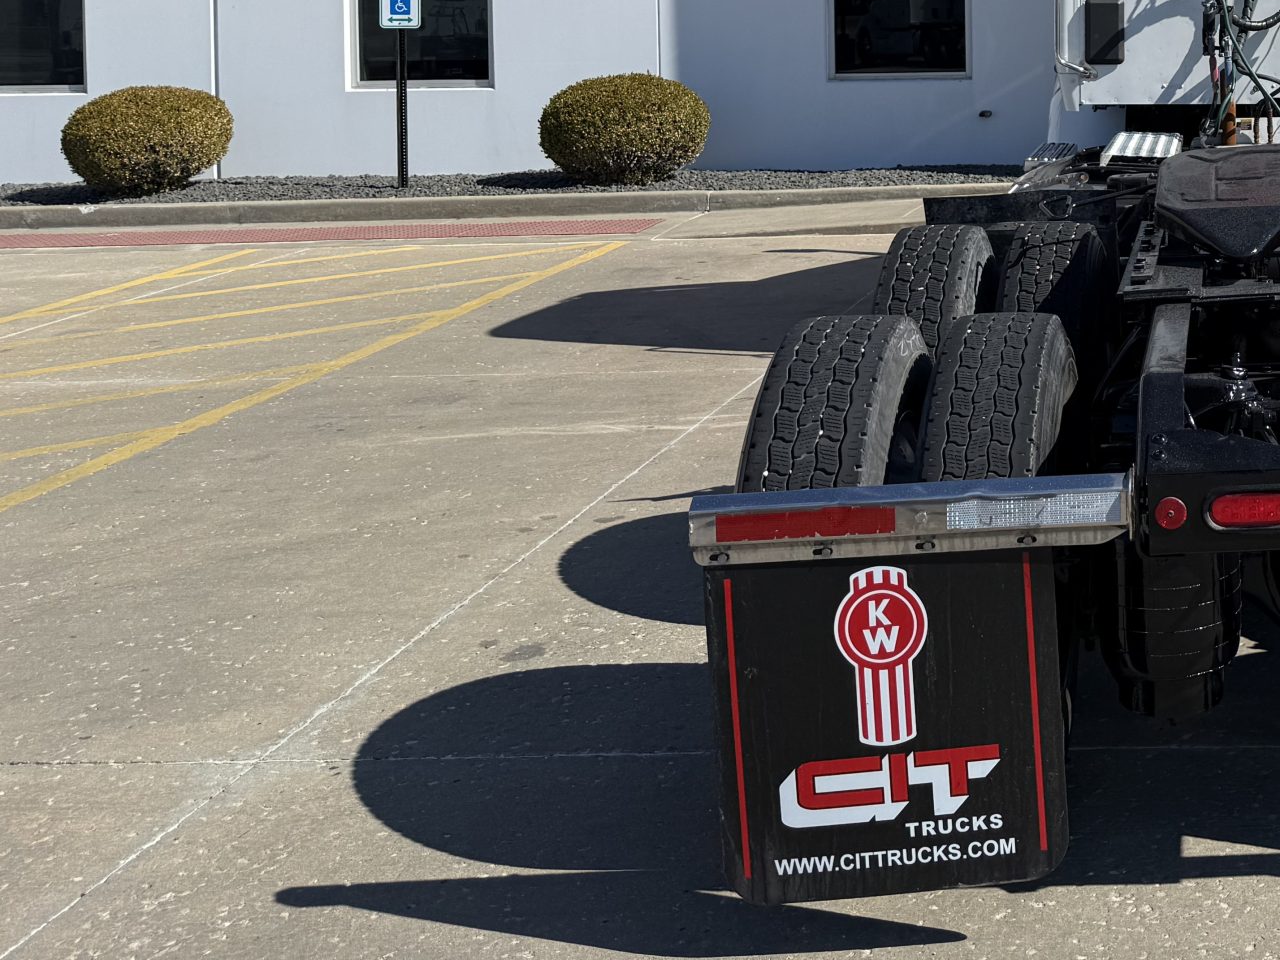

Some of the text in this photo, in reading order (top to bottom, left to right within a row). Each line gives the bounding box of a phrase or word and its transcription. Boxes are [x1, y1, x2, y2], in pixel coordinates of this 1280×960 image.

[868, 598, 891, 627] K
[862, 626, 900, 655] W
[778, 743, 1001, 829] CIT
[904, 813, 1003, 838] TRUCKS
[774, 837, 1017, 876] WWW.CITTRUCKS.COM
